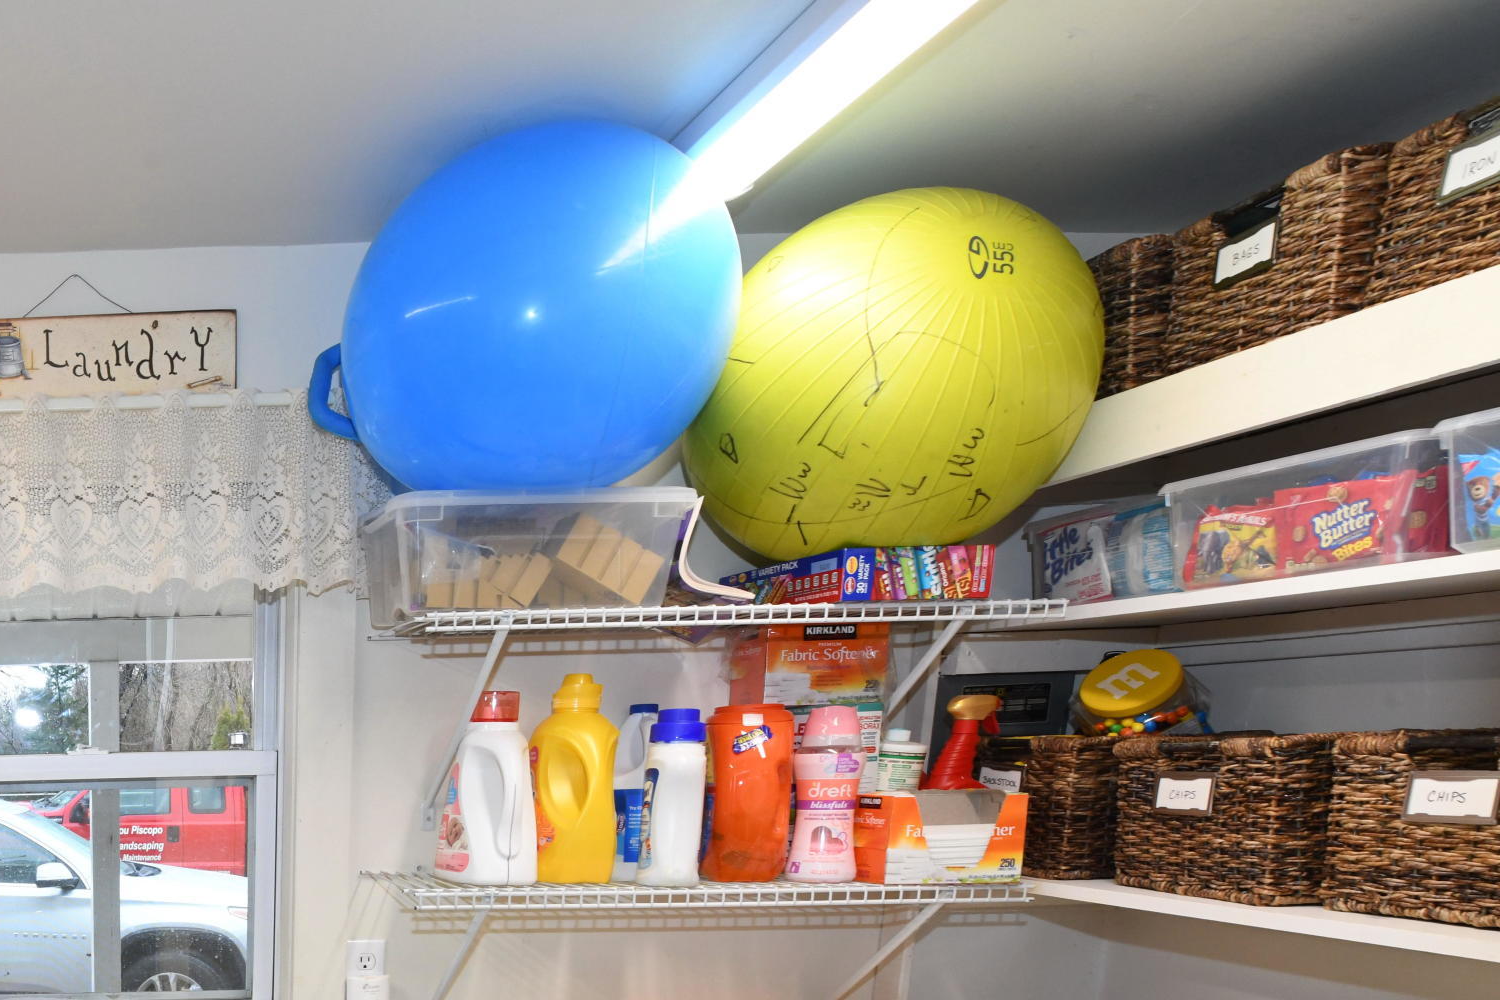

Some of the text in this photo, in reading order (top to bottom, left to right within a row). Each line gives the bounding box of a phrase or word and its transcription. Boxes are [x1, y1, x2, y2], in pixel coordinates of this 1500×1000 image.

[1312, 499, 1368, 534] Nutter
[1319, 511, 1376, 549] Butter
[1332, 537, 1373, 561] Bites
[758, 560, 799, 577] VARIETY PACK
[855, 582, 865, 594] 30
[805, 625, 856, 636] KIRKLAND
[780, 648, 819, 662] Fabric
[808, 782, 853, 798] dreft
[1426, 789, 1468, 804] CHIPS
[810, 801, 848, 810] blissfuls
[130, 825, 164, 836] Piscopo
[119, 841, 165, 852] andscaping
[1000, 858, 1015, 868] 250
